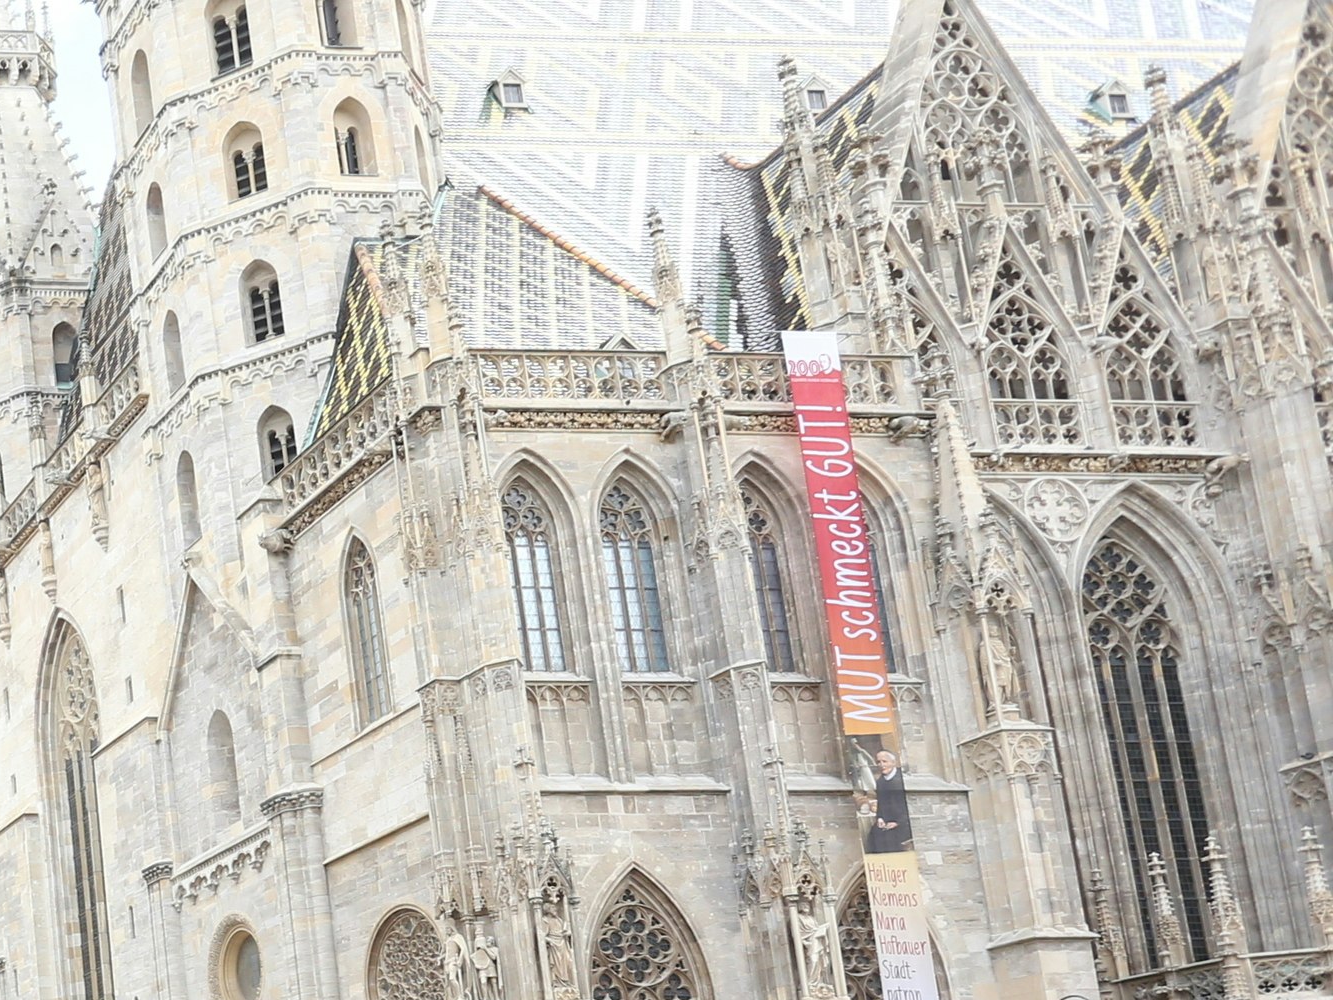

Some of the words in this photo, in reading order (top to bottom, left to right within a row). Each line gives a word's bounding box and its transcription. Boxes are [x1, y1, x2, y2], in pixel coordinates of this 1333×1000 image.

[795, 404, 853, 477] GUT!
[813, 489, 877, 642] schmeckt
[835, 645, 891, 723] MUT
[868, 863, 908, 888] Heiliger
[871, 886, 918, 907] Klemens
[876, 910, 907, 931] Maria
[880, 935, 927, 956] Hofbauer
[883, 960, 917, 980] Stadt-
